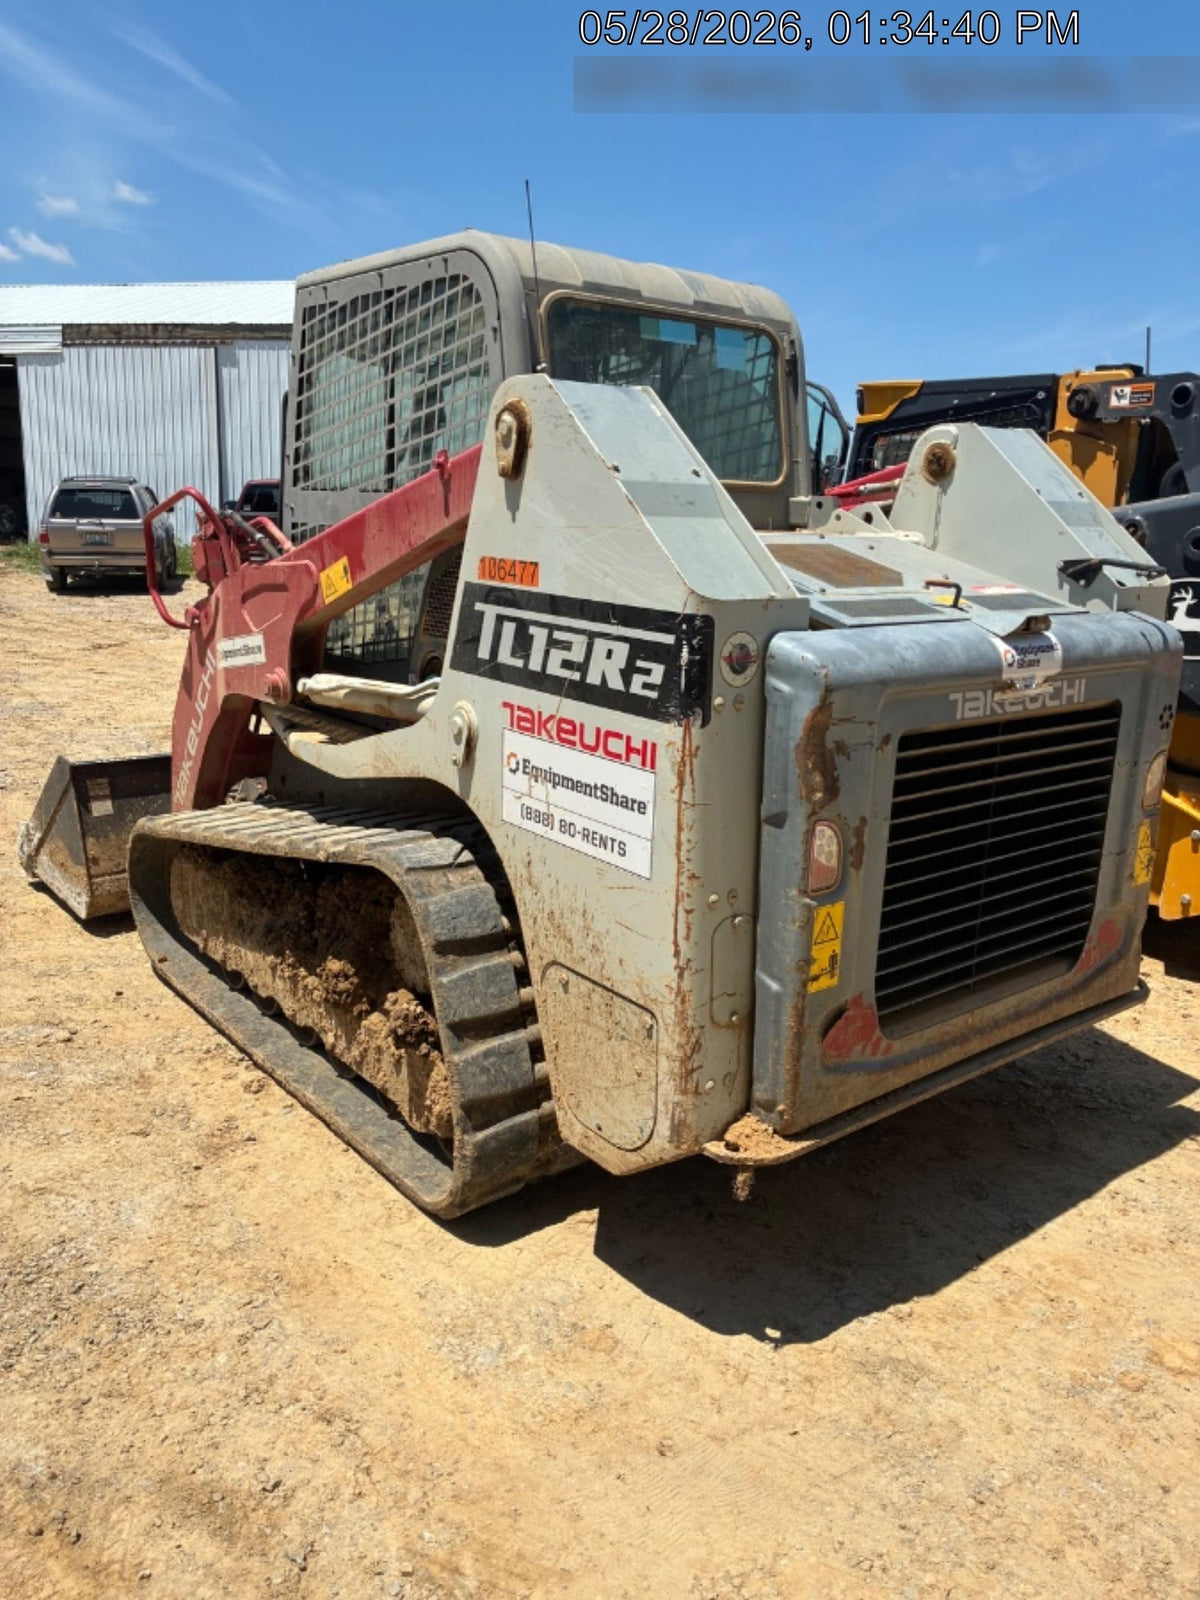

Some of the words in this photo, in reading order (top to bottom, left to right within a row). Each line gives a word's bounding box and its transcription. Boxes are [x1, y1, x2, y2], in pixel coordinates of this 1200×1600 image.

[480, 556, 539, 585] 106477
[474, 602, 677, 699] TL12R2
[521, 758, 649, 815] EquipmentShare
[520, 803, 555, 831] (888)
[559, 819, 627, 858] 80-RENTS
